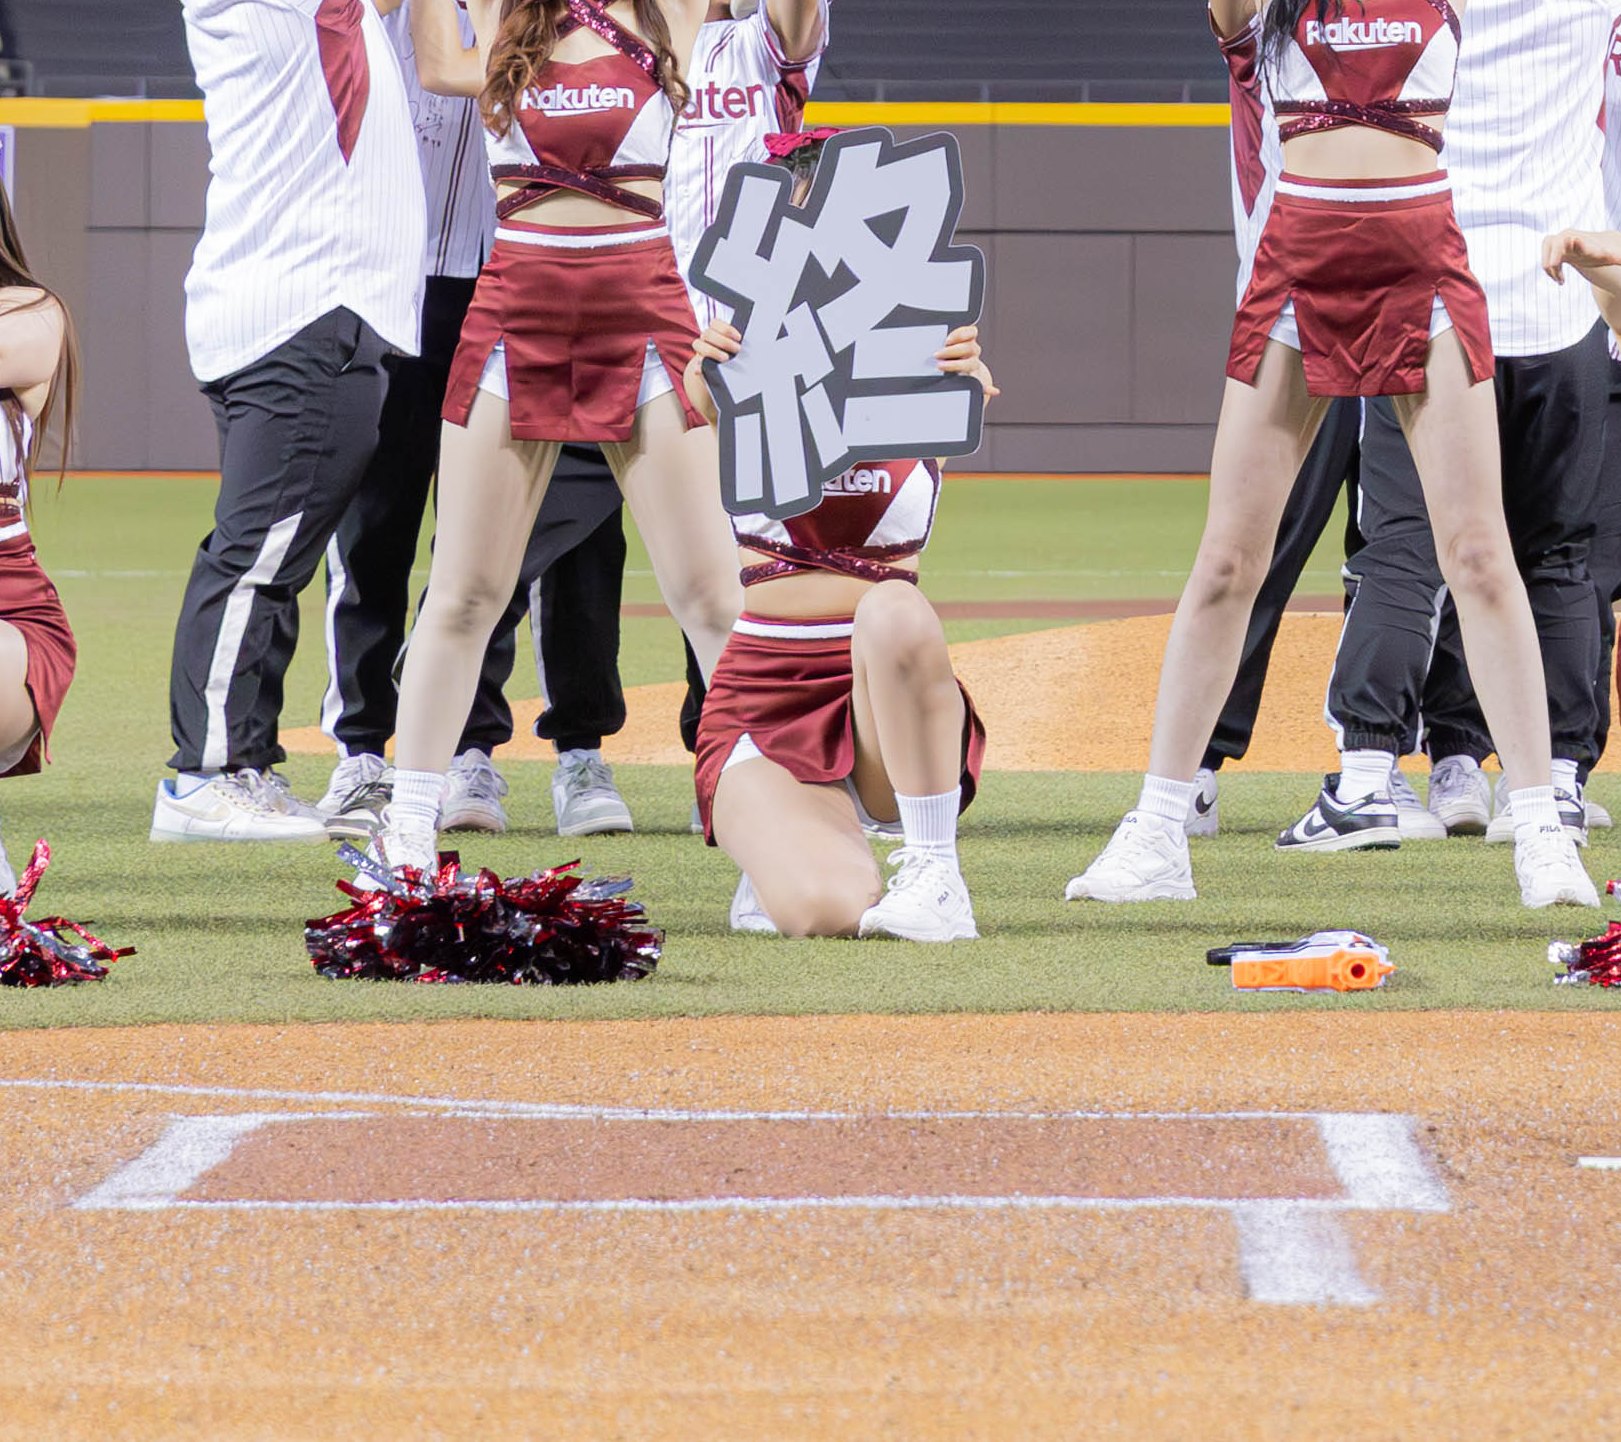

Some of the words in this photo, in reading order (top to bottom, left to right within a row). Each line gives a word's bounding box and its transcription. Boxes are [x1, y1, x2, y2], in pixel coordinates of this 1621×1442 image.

[1305, 16, 1423, 52] Rakuten
[520, 82, 636, 118] Rakuten
[702, 141, 976, 507] 終
[823, 468, 892, 496] uten
